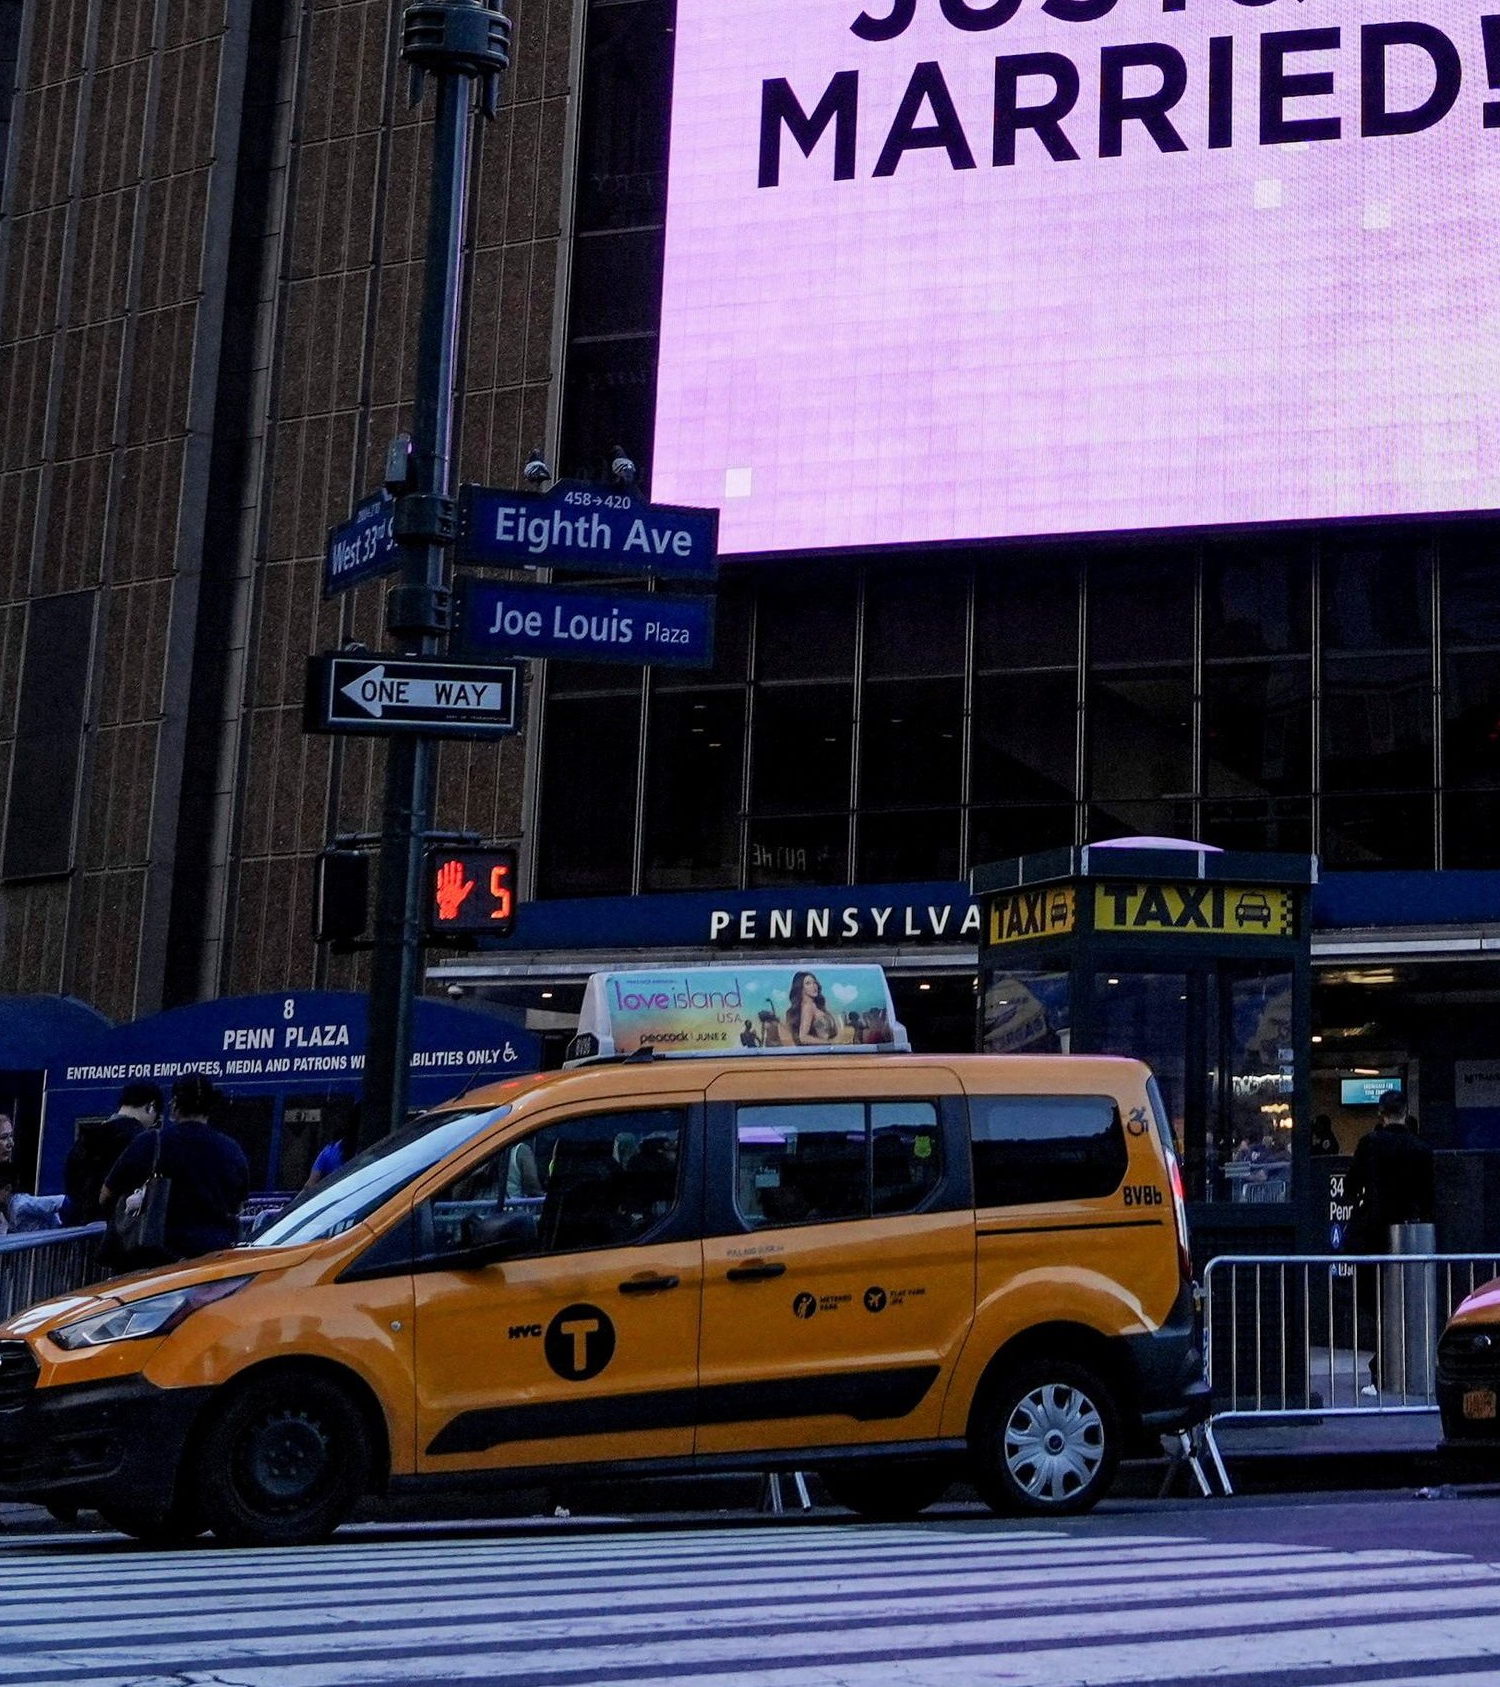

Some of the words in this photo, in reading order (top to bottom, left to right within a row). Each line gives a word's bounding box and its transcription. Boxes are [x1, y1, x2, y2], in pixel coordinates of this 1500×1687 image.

[564, 491, 592, 507] 458
[604, 494, 631, 509] 420
[495, 506, 611, 554] Eighth
[623, 519, 693, 556] Ave
[332, 535, 361, 576] West
[490, 601, 542, 636] Joe
[553, 606, 633, 643] Louis
[645, 622, 690, 644] Plaza
[361, 678, 410, 703] ONE
[435, 682, 487, 707] WAY
[490, 865, 511, 919] 5
[1104, 884, 1225, 928] TAXI
[710, 904, 980, 940] PENNSYLVA
[995, 890, 1047, 940] TAXI
[283, 998, 295, 1020] 8
[614, 979, 670, 1011] love
[671, 977, 742, 1009] island
[717, 1012, 742, 1024] USA
[223, 1029, 274, 1050] PENN
[285, 1024, 349, 1048] PLAZA
[639, 1030, 689, 1044] peacock
[695, 1032, 718, 1042] JUNE
[720, 1032, 728, 1042] 2
[67, 1064, 126, 1080] ENTRANCE
[128, 1063, 151, 1078] FOR
[226, 1059, 262, 1075] MEDIA
[265, 1058, 290, 1073] AND
[293, 1055, 347, 1072] PATRONS
[350, 1054, 366, 1070] WI
[409, 1050, 464, 1068] BILITIES
[466, 1049, 501, 1064] ONLY
[1330, 1177, 1344, 1198] 34
